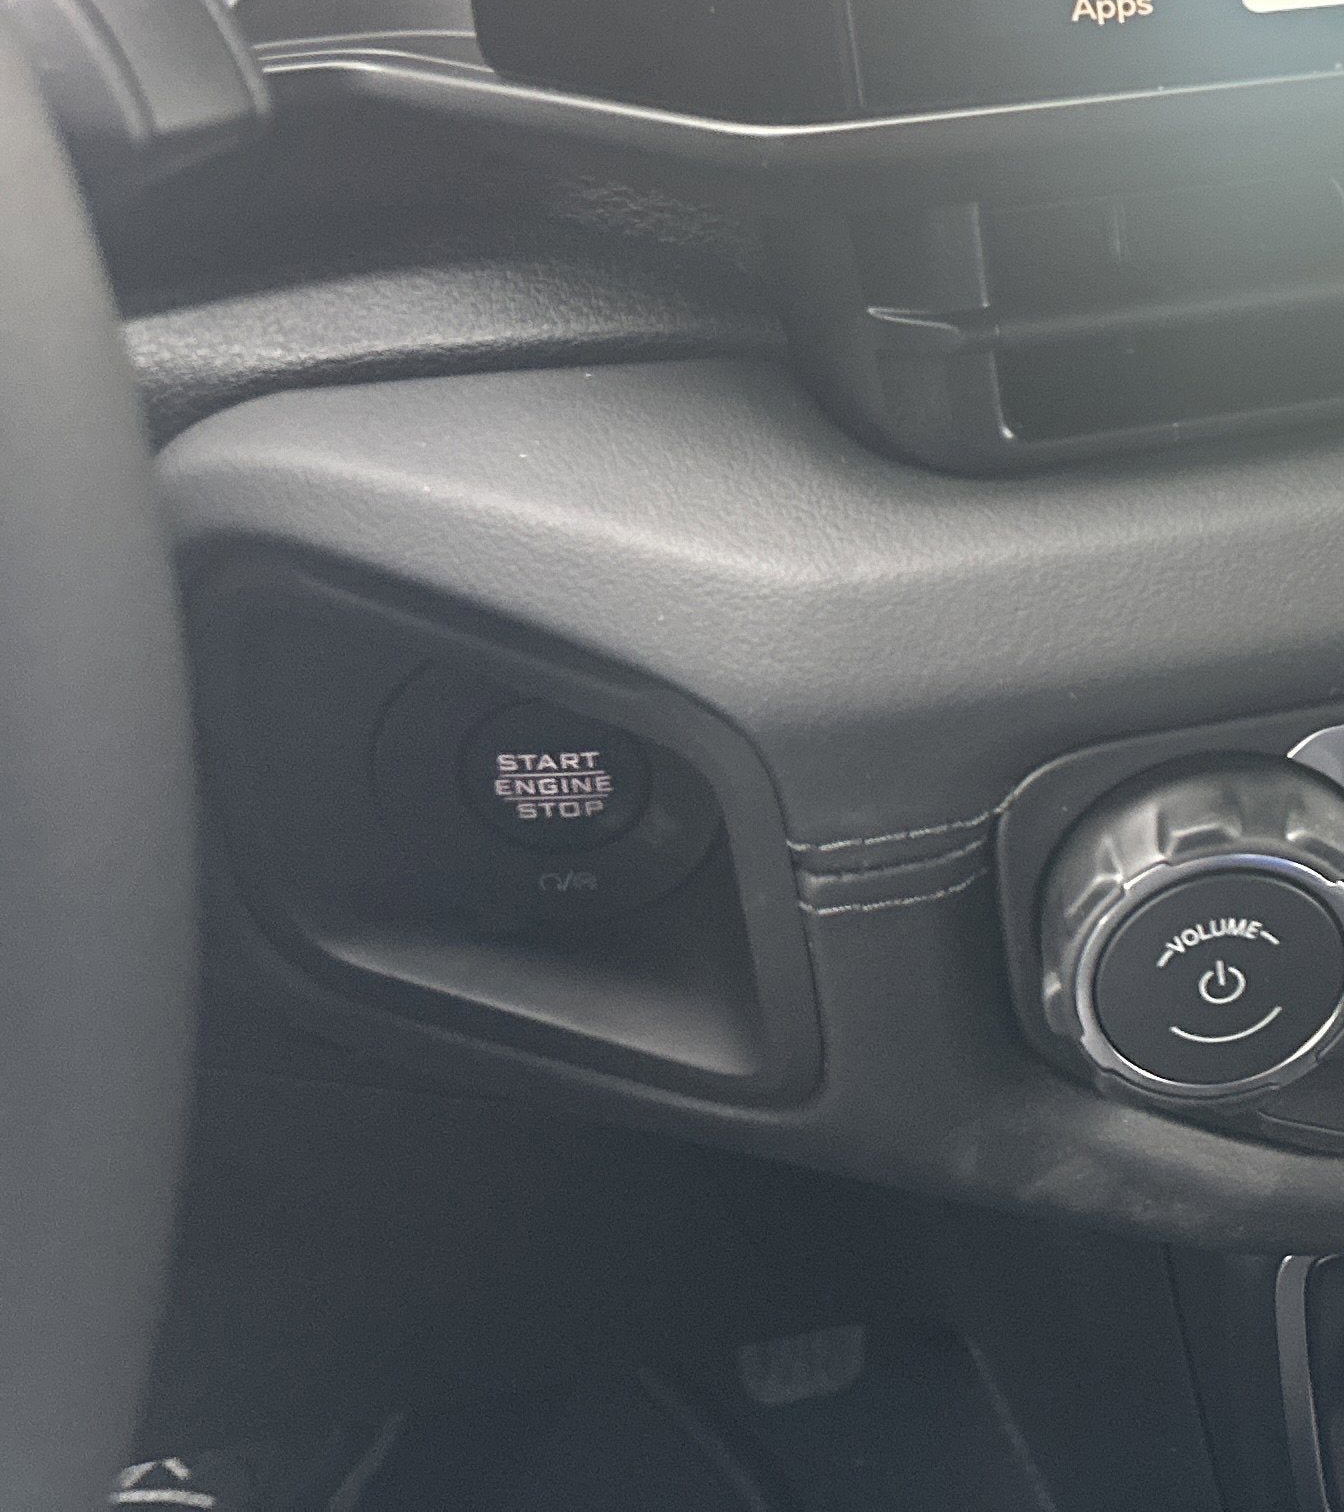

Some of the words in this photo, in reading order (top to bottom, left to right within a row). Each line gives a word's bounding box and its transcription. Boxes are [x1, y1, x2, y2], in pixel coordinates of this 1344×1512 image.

[497, 751, 599, 772] START
[494, 775, 614, 796] ENGINE
[516, 801, 604, 819] STOP
[1165, 918, 1263, 954] VOLUME
